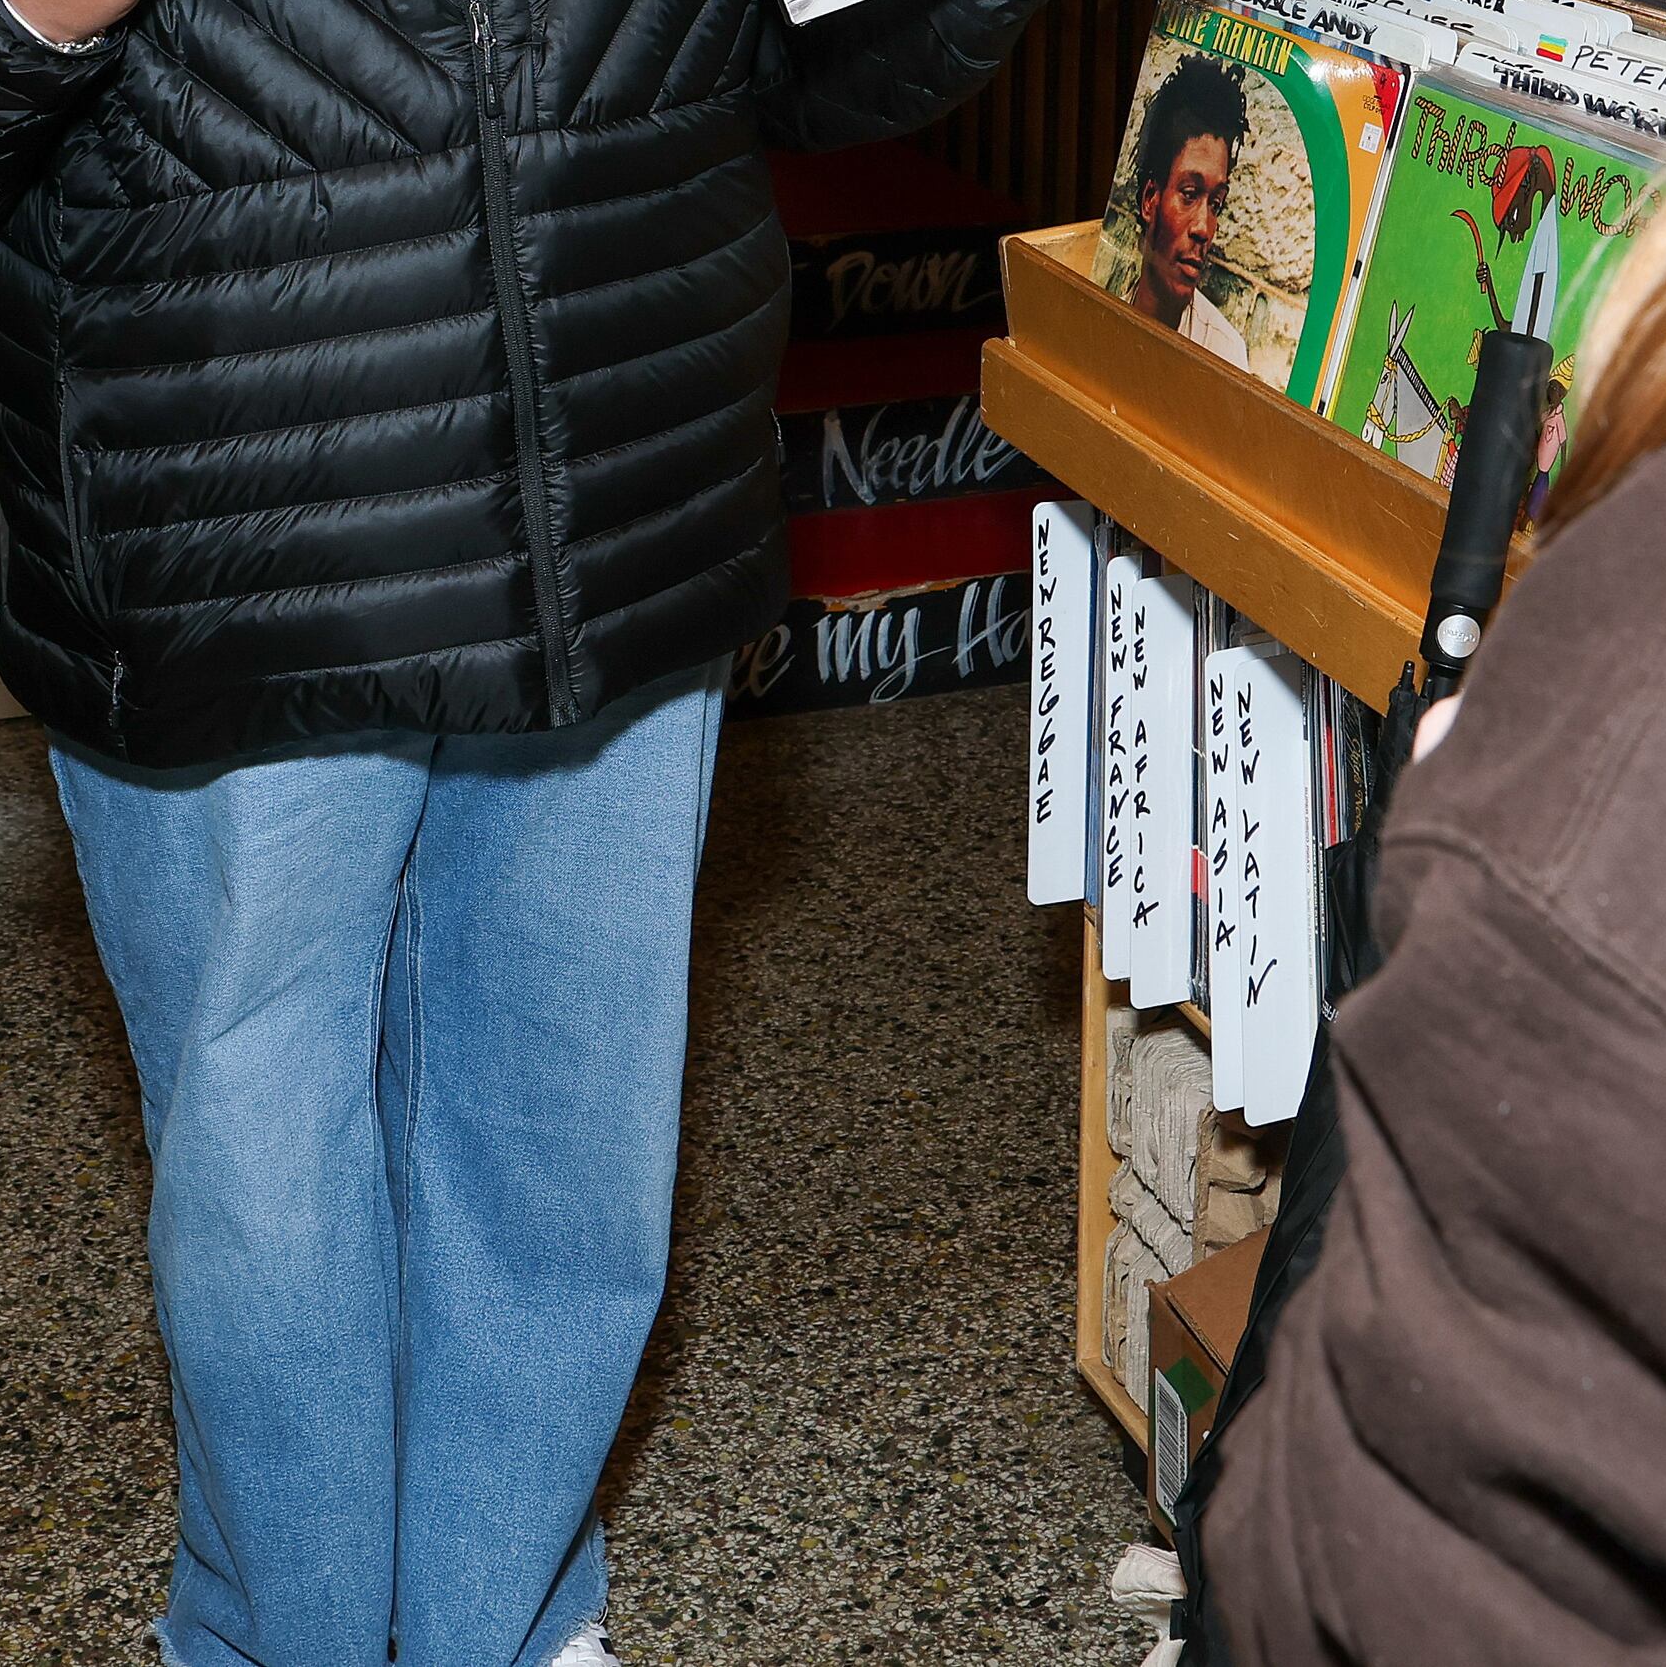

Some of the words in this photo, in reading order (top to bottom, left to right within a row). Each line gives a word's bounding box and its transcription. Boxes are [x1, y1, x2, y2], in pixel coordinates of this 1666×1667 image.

[1309, 8, 1379, 46] ANDY
[1494, 64, 1580, 107] THIRD
[827, 245, 1003, 319] Down
[823, 395, 1026, 510] Needle
[1035, 518, 1057, 608] NEW
[815, 605, 955, 705] my
[1107, 582, 1127, 673] NEW
[1131, 605, 1149, 693] NEW
[1034, 616, 1058, 826] REGGAE
[1208, 672, 1229, 776] NEW
[1236, 681, 1261, 786] NEW
[1105, 694, 1130, 889] FRANCE
[1131, 718, 1160, 930] AFRICA
[1211, 797, 1237, 953] ASIA
[1242, 807, 1278, 1010] LATIN
